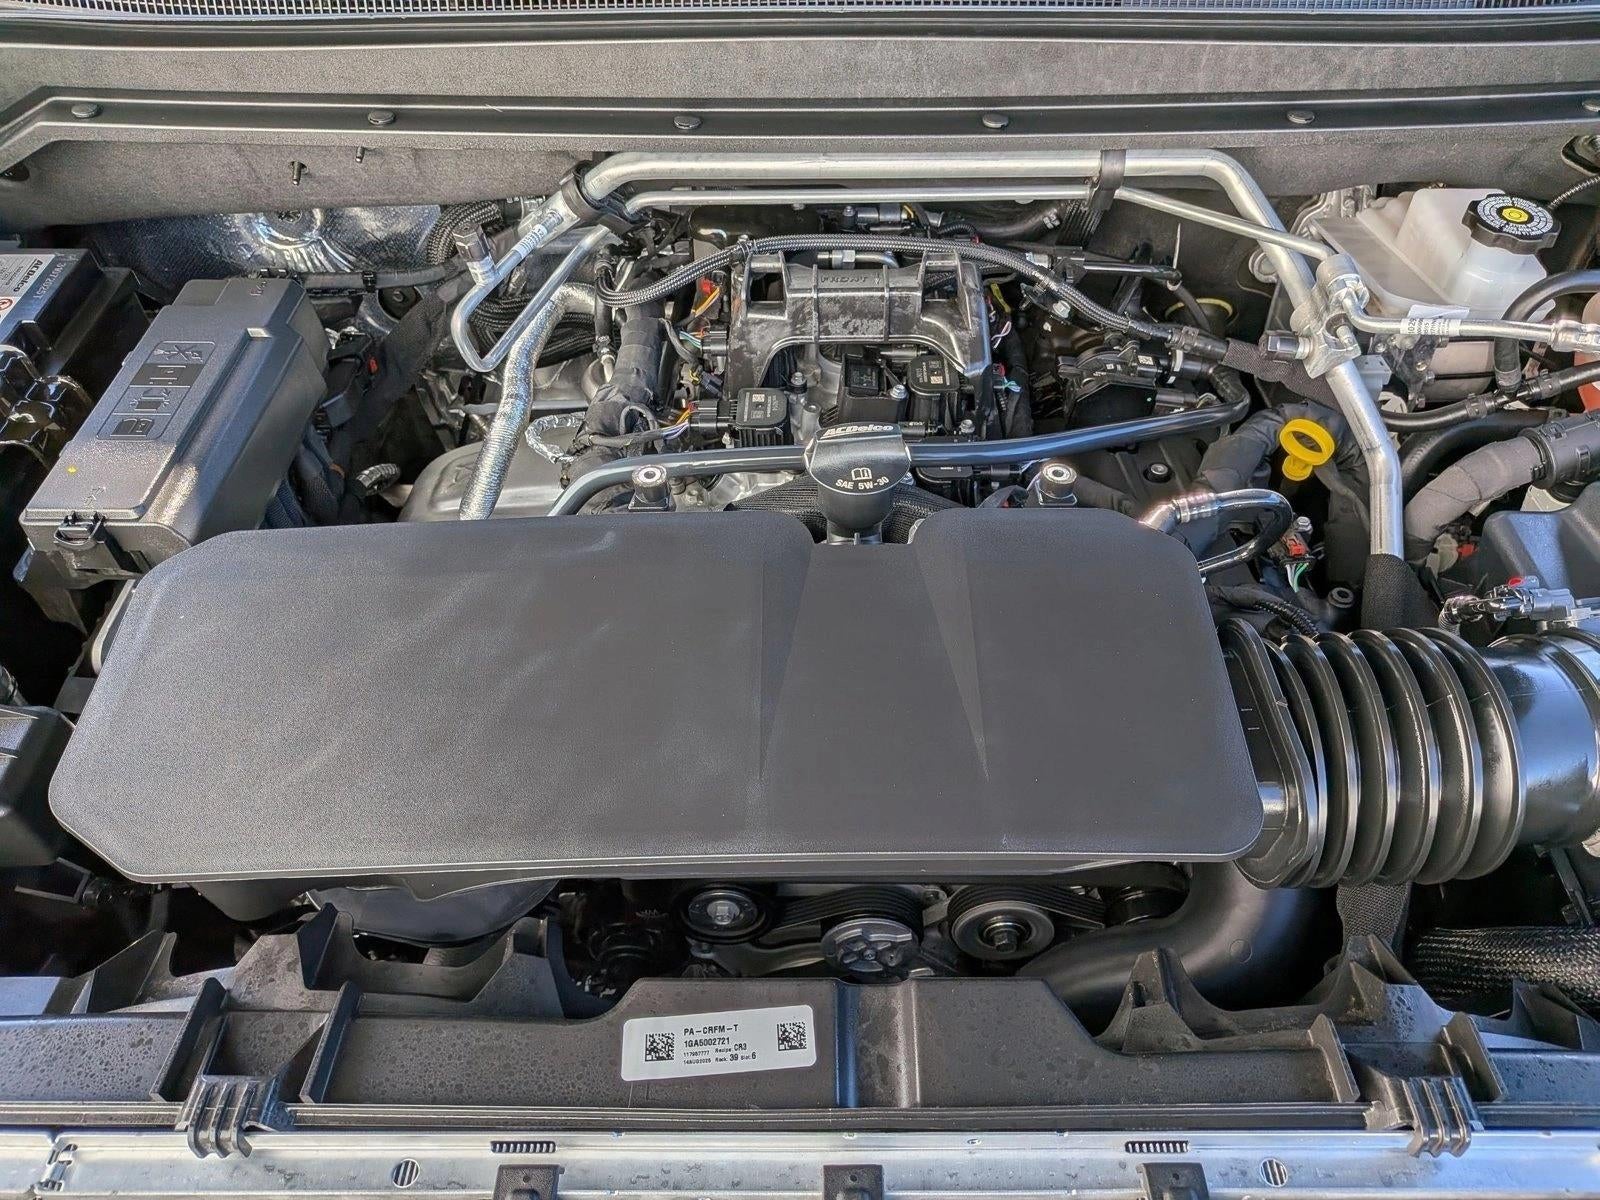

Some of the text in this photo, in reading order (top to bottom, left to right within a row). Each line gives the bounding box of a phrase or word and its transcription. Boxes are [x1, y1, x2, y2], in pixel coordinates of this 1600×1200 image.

[13, 259, 43, 291] ACDelco
[823, 424, 893, 436] ACDelco
[835, 476, 890, 489] SAE 5W-30
[684, 1037, 729, 1047] 1GA5002721
[734, 1043, 747, 1051] CR3
